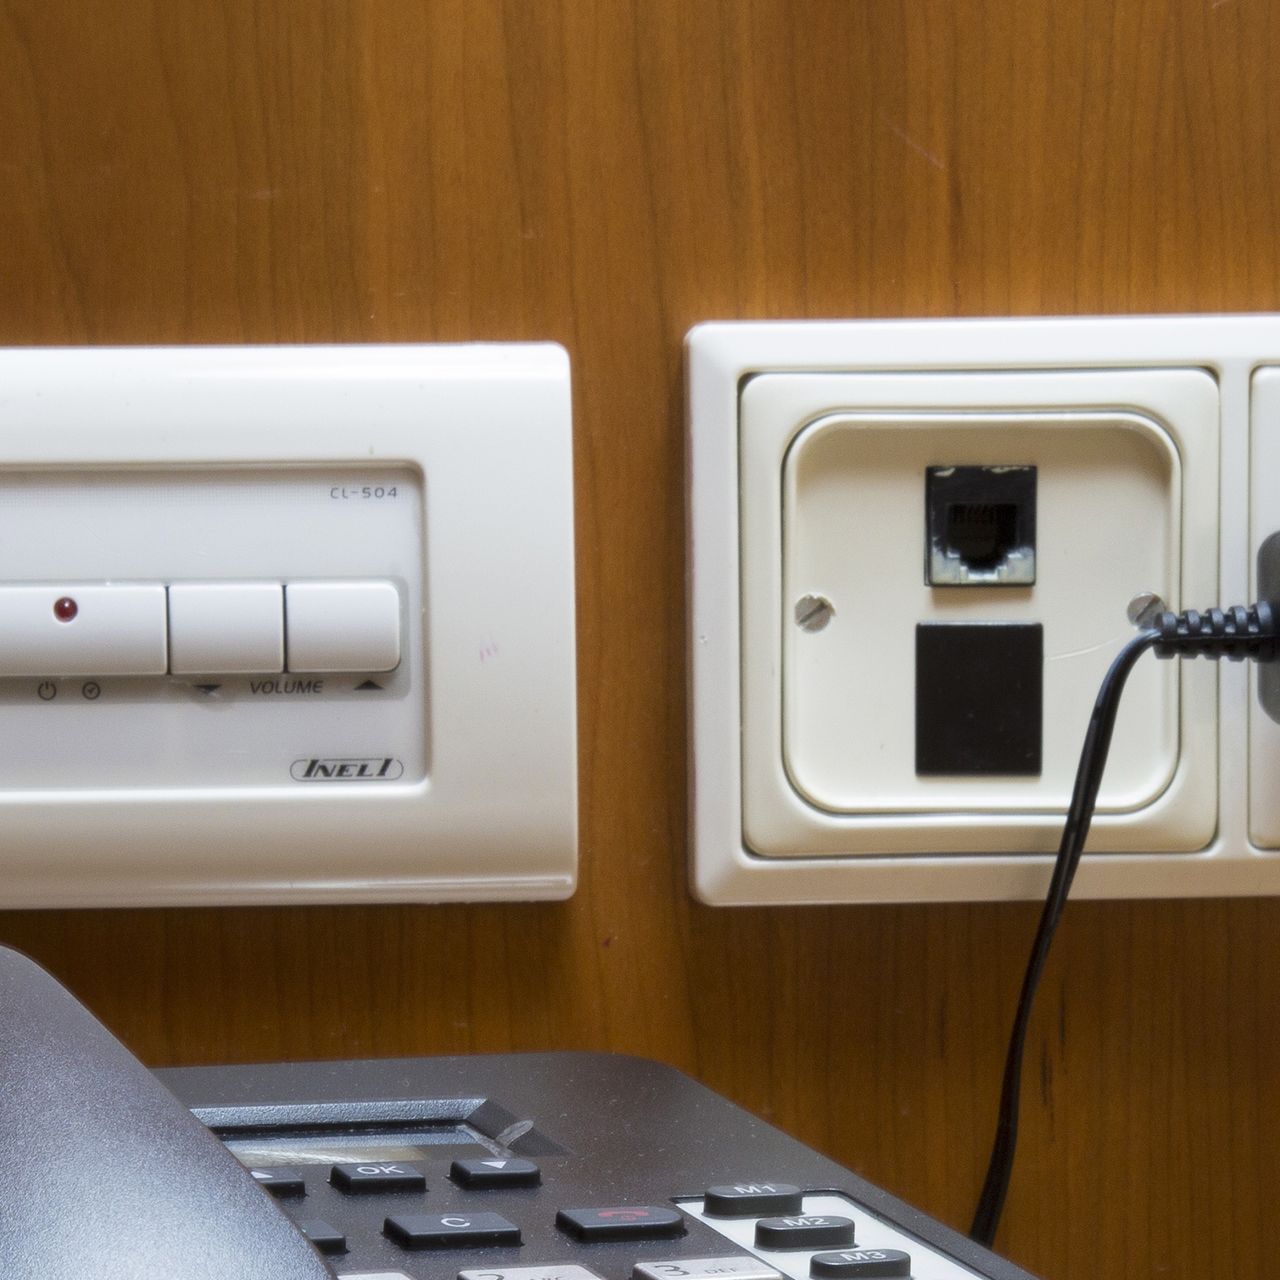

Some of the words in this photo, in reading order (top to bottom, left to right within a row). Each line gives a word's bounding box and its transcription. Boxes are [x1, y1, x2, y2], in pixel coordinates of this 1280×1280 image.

[330, 487, 398, 500] CL-504
[250, 680, 324, 695] VOLUME
[303, 758, 394, 779] INELI
[357, 1165, 405, 1176] OK
[734, 1184, 777, 1195] M1
[441, 1217, 471, 1228] C
[782, 1217, 830, 1227] M2
[840, 1251, 887, 1263] M3
[654, 1265, 691, 1277] 3
